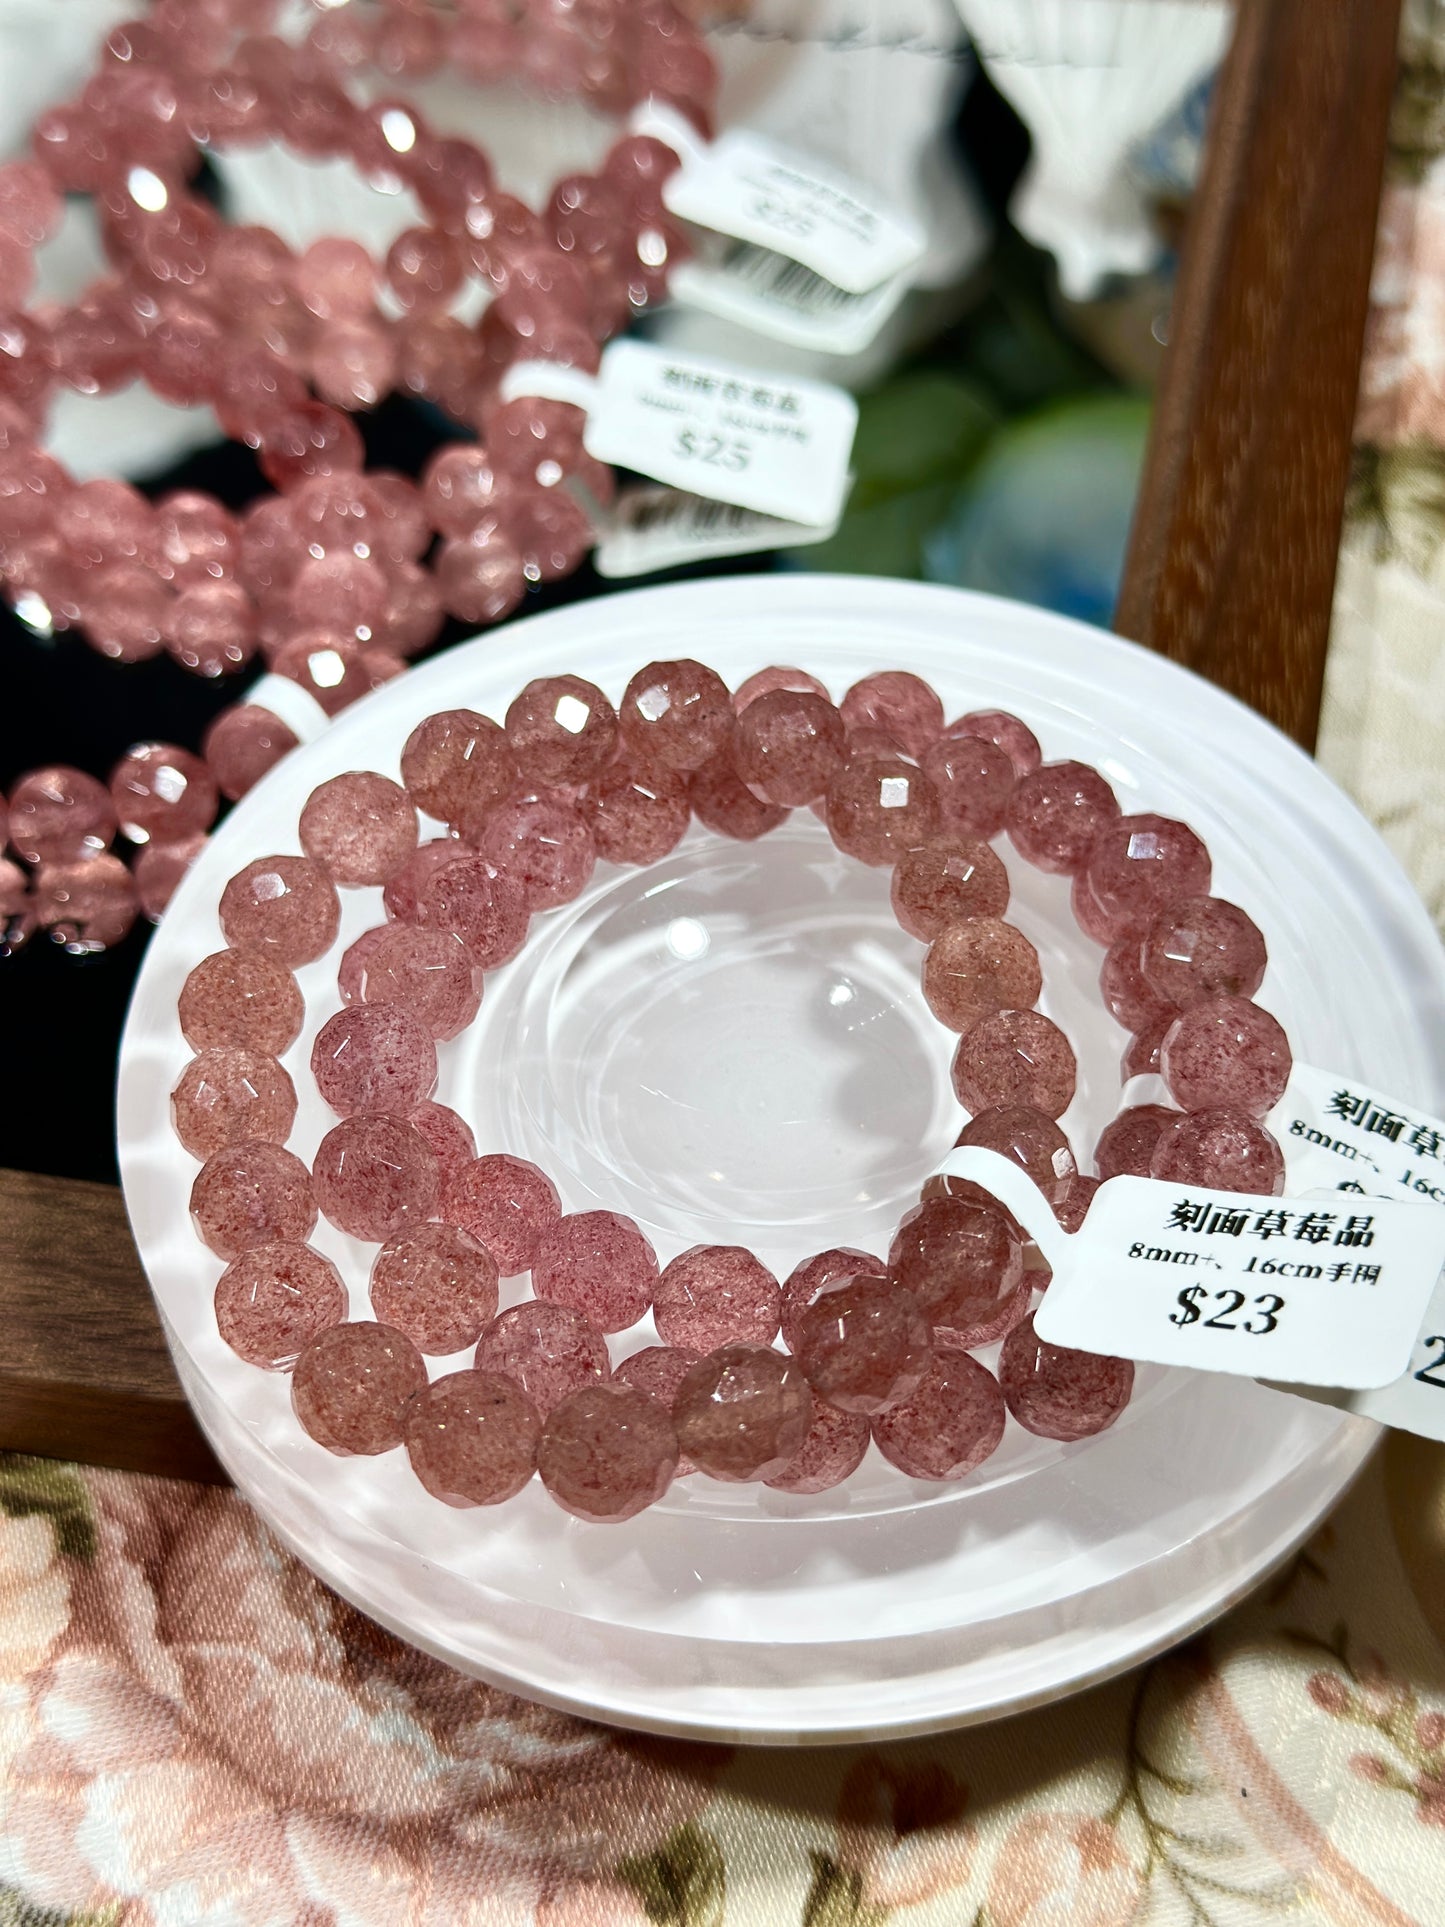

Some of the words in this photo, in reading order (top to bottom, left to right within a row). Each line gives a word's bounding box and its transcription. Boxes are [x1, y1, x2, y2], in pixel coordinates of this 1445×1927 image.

[674, 429, 751, 472] $25
[1323, 1088, 1445, 1165] 刻面草
[1163, 1199, 1376, 1248] 刻面草莓晶
[1167, 1282, 1286, 1335] $23
